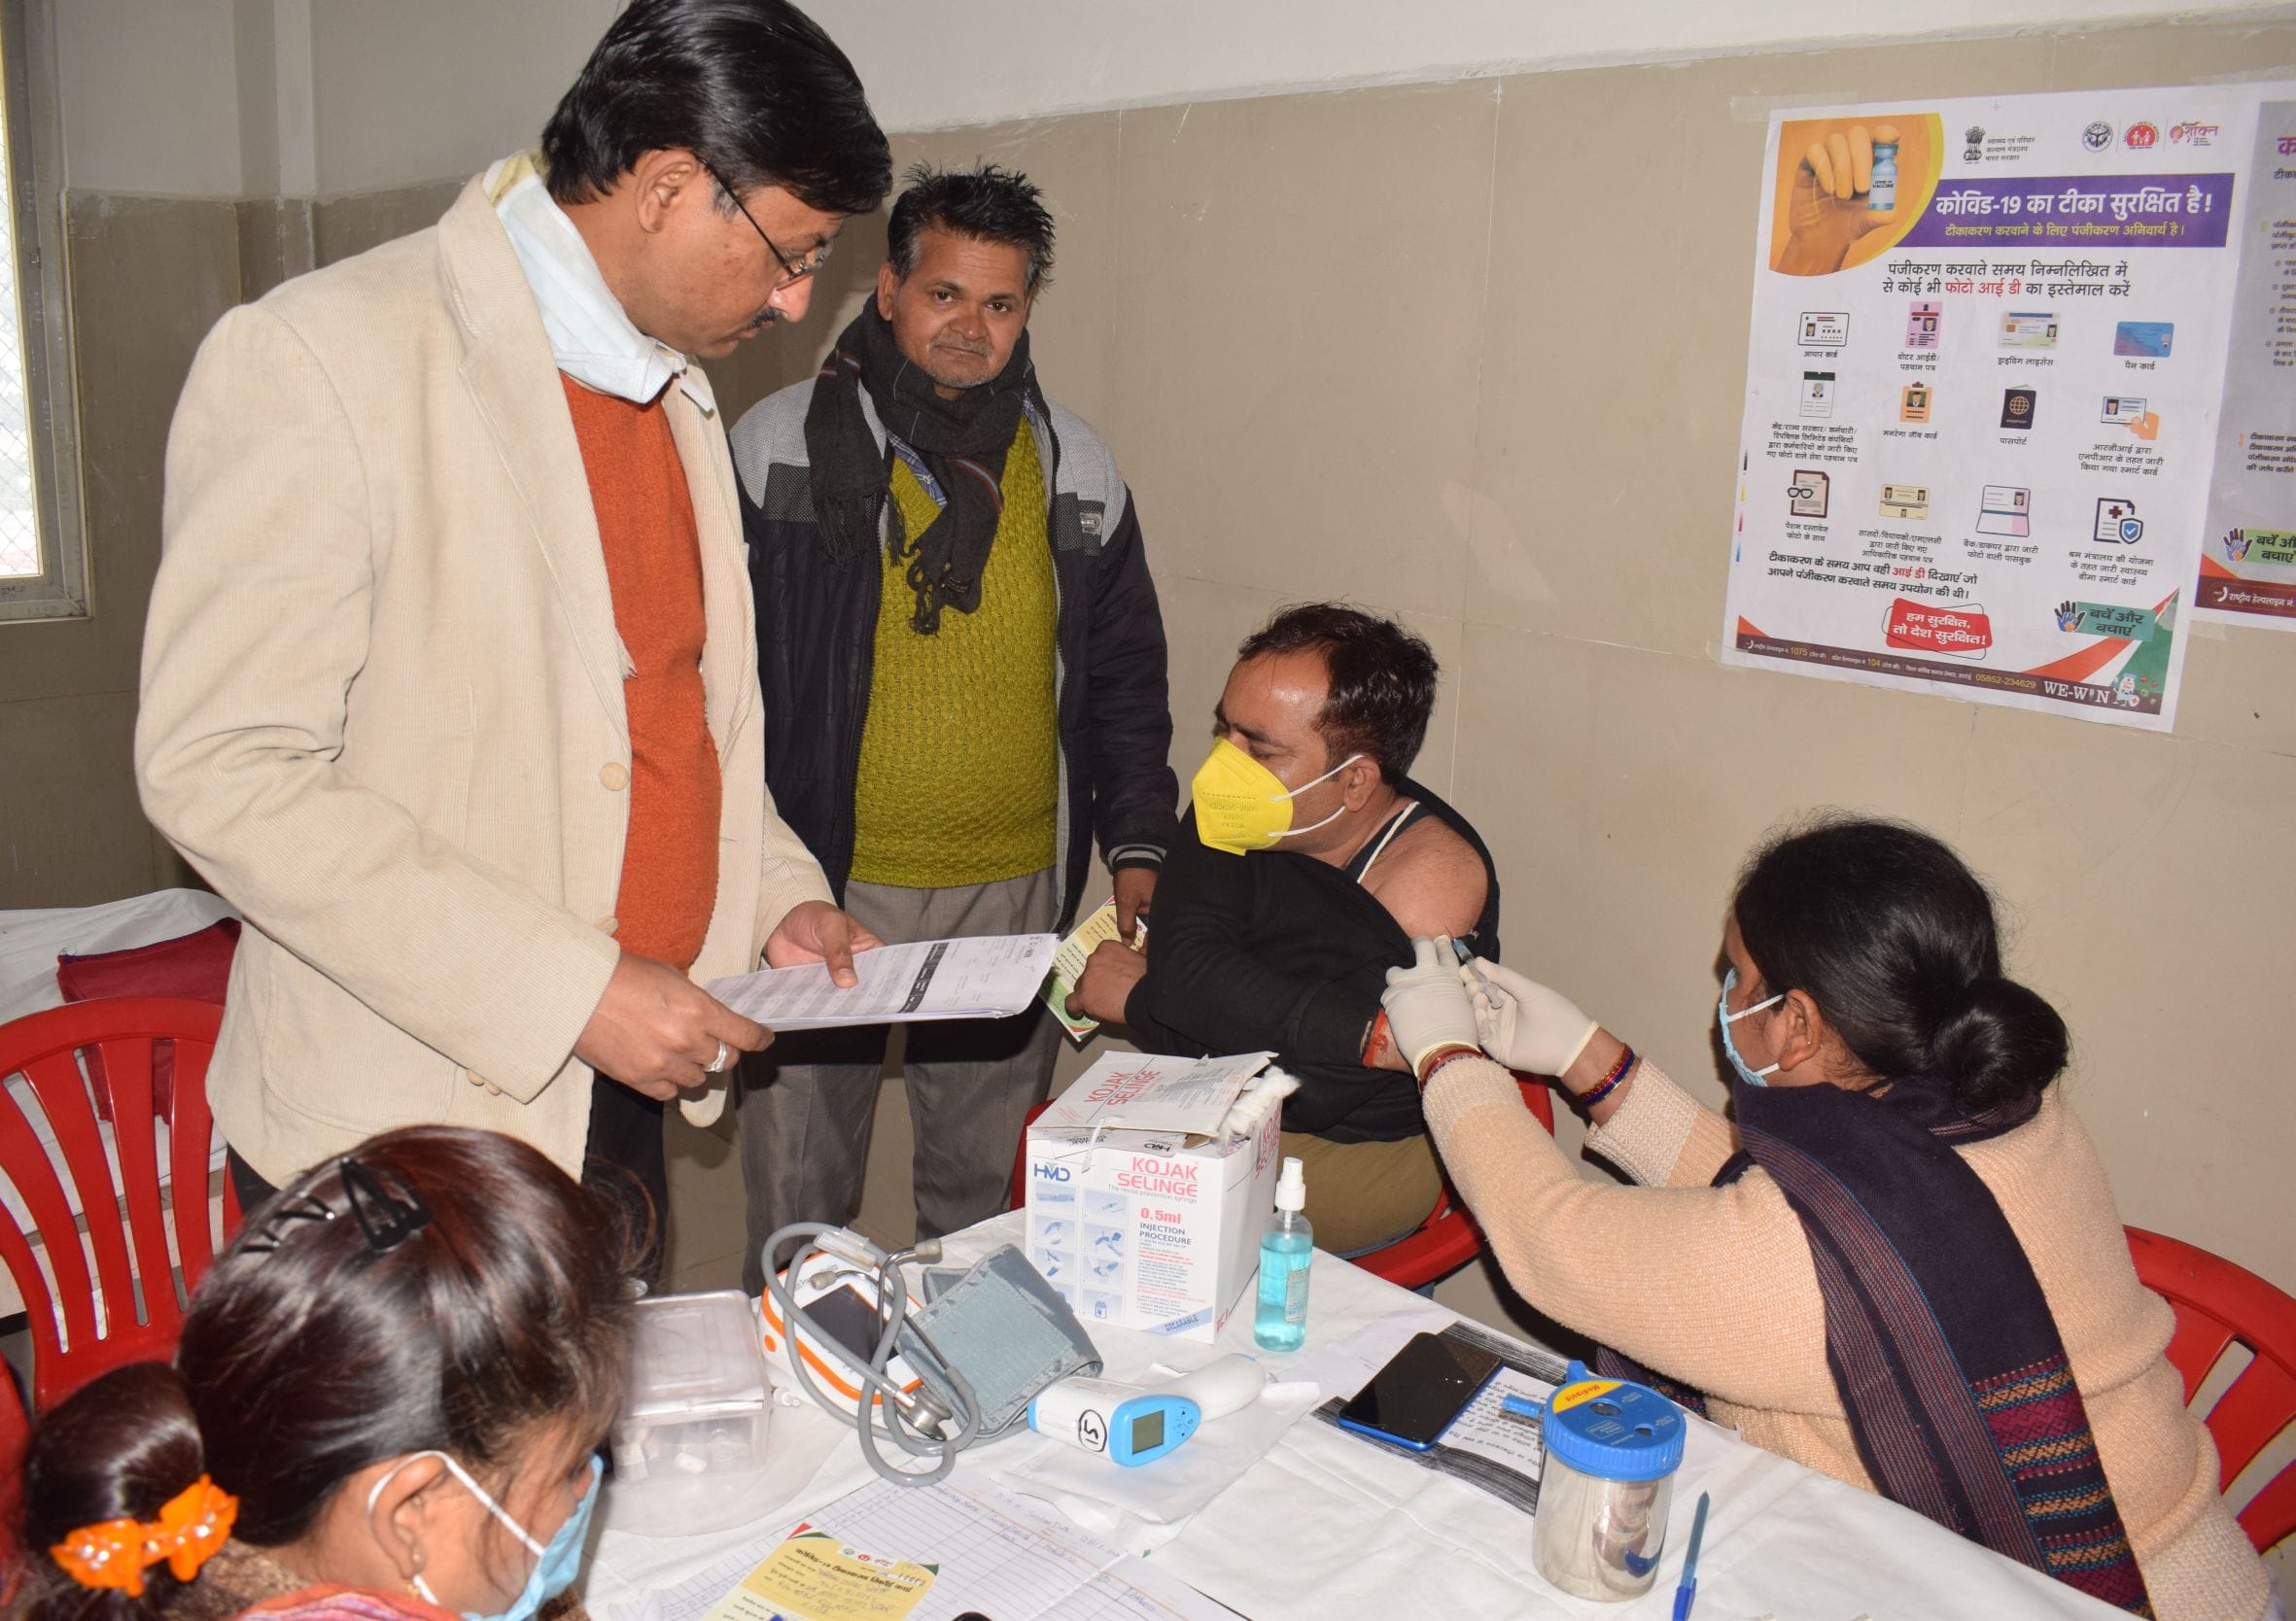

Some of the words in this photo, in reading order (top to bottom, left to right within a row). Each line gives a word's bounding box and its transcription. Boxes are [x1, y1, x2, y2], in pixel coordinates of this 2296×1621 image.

[1935, 190, 2022, 215] कोविड-19
[2027, 194, 2055, 214] का
[2058, 188, 2105, 214] टीका
[2110, 187, 2181, 221] सुरक्षित
[1945, 224, 1992, 236] टीकाकरण
[1995, 223, 2030, 236] करवाने
[2033, 223, 2043, 236] के
[2046, 223, 2068, 236] लिए
[2071, 223, 2119, 236] पंजीकरण
[2123, 222, 2168, 236] अनिवार्य
[1889, 259, 1941, 276] पंजीकरण
[1946, 259, 1987, 276] करवाते
[1992, 263, 2026, 276] समय
[2031, 259, 2110, 277] निम्नलिखित
[2115, 260, 2128, 277] में
[1883, 279, 1894, 293] से
[1897, 277, 1922, 296] कोई
[1927, 279, 1941, 293] भी
[1945, 277, 1973, 293] फोटो
[1978, 277, 2005, 296] आई
[2008, 280, 2022, 294] डी
[2026, 283, 2042, 295] का
[2047, 279, 2105, 297] इस्तेमाल
[2108, 279, 2131, 296] करें
[2139, 361, 2156, 370] कार्ड
[2000, 436, 2028, 445] पासपोर्ट
[2115, 454, 2123, 463] के
[2145, 456, 2164, 466] जारी
[2142, 466, 2158, 476] कार्ड
[2256, 534, 2279, 546] बचें
[1768, 550, 1812, 567] टीकाकरण
[1814, 556, 1826, 567] के
[1826, 559, 1850, 570] समय
[1852, 562, 1871, 572] आप
[1873, 563, 1890, 575] वही
[1893, 565, 1911, 578] आई
[1914, 566, 1926, 579] डी
[1928, 569, 1963, 583] दिखाएं
[1964, 572, 1978, 584] जो
[1767, 567, 1793, 578] आपने
[1795, 569, 1836, 584] पंजीकरण
[1838, 575, 1870, 588] करवाते
[1872, 579, 1896, 591] समय
[1899, 582, 1933, 596] उपयोग
[1935, 585, 1950, 598] की
[1906, 612, 1925, 622] हम
[2090, 607, 2115, 620] बचें
[2115, 610, 2145, 624] और
[1893, 623, 1908, 635] तो
[1910, 625, 1932, 638] देश
[1935, 630, 1986, 644] सुरक्षित!
[2096, 623, 2136, 636] बचाएं
[1790, 646, 1808, 657] 1075
[1867, 658, 1881, 668] 104
[1084, 1072, 1133, 1103] KOJAK
[1106, 1069, 1162, 1106] SELINGE
[1034, 1163, 1070, 1183] HMD
[1132, 1156, 1198, 1181] KOJAK
[1117, 1172, 1198, 1197] SELINGE
[1140, 1207, 1182, 1224] 0.5ml
[1139, 1223, 1186, 1235] INJECTION
[1139, 1230, 1192, 1245] PROCEDURE
